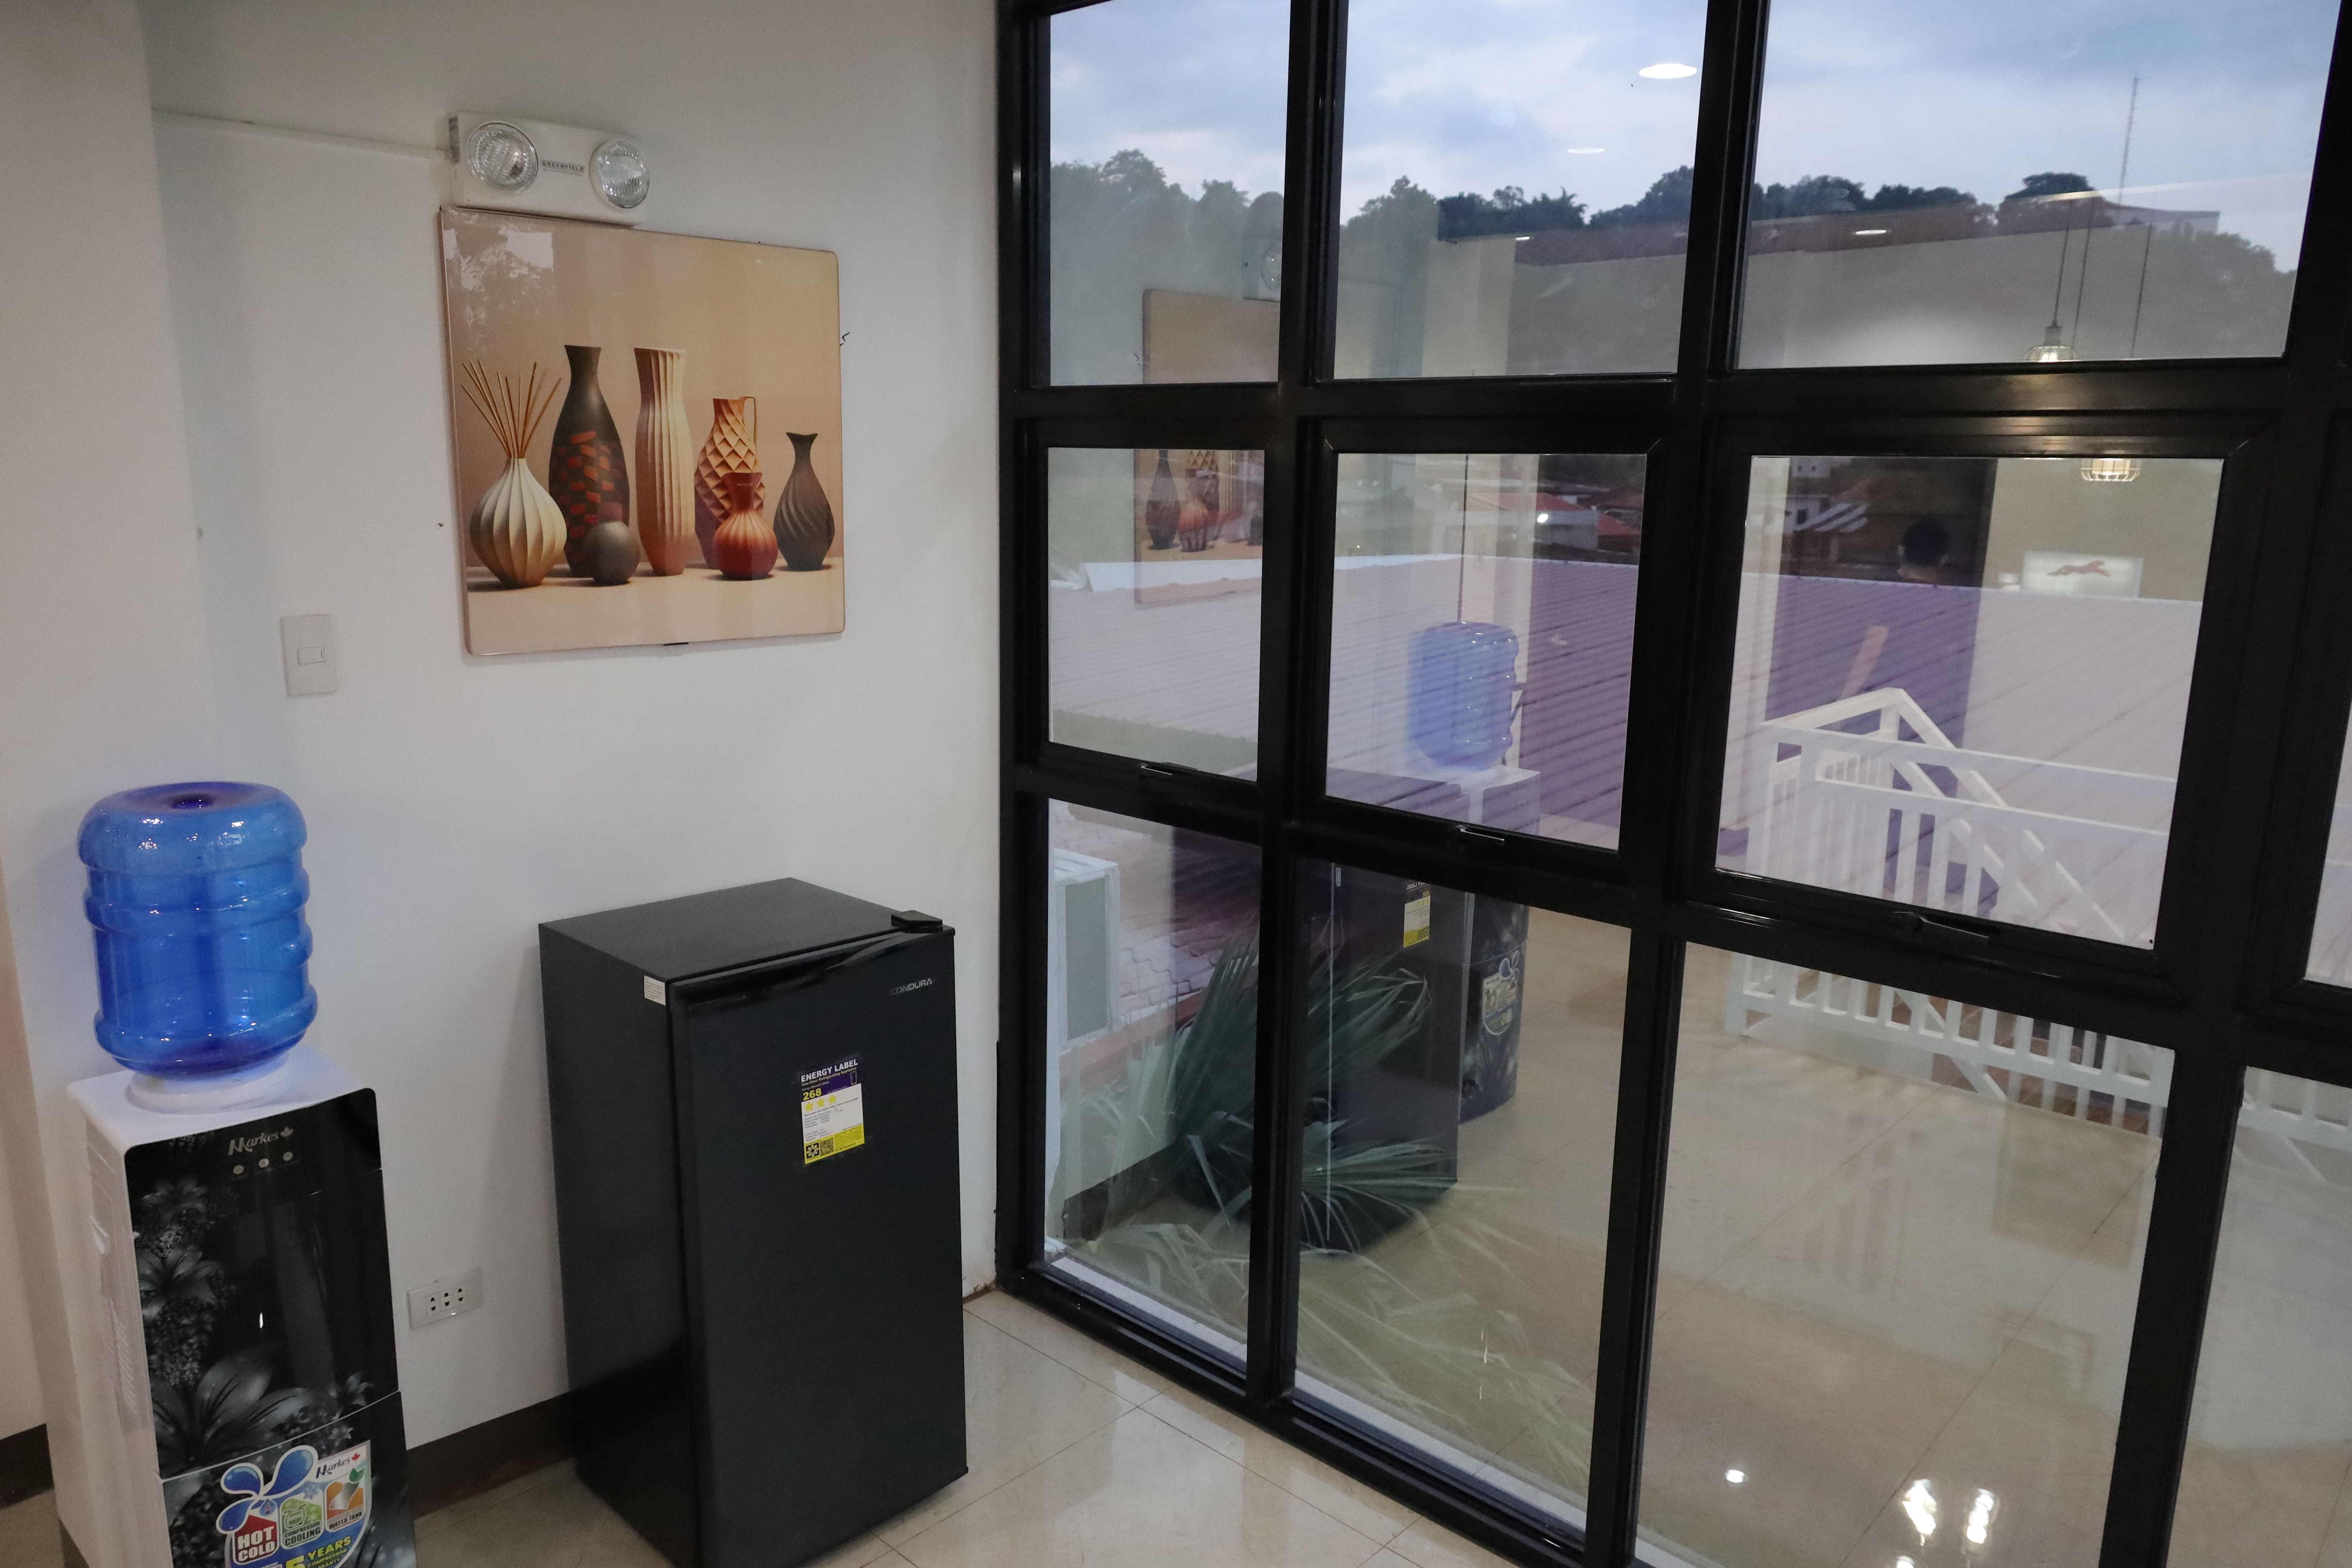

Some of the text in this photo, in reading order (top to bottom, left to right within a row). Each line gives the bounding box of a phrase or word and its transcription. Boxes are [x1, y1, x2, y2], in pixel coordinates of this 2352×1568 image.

[542, 161, 583, 171] GREENFIELD
[891, 978, 933, 995] CONDURA
[801, 1059, 858, 1083] ENERGY LABEL
[803, 1088, 822, 1101] 268
[228, 1132, 279, 1155] Markes
[315, 1457, 351, 1479] Markes
[285, 1521, 320, 1538] COMPRESSOR
[329, 1516, 348, 1530] WATER
[349, 1511, 363, 1521] TANK
[237, 1526, 274, 1550] HOT
[285, 1527, 320, 1546] COOLING
[238, 1541, 275, 1562] COLD
[307, 1536, 352, 1560] YEARS
[307, 1548, 348, 1568] COMPRESSOR
